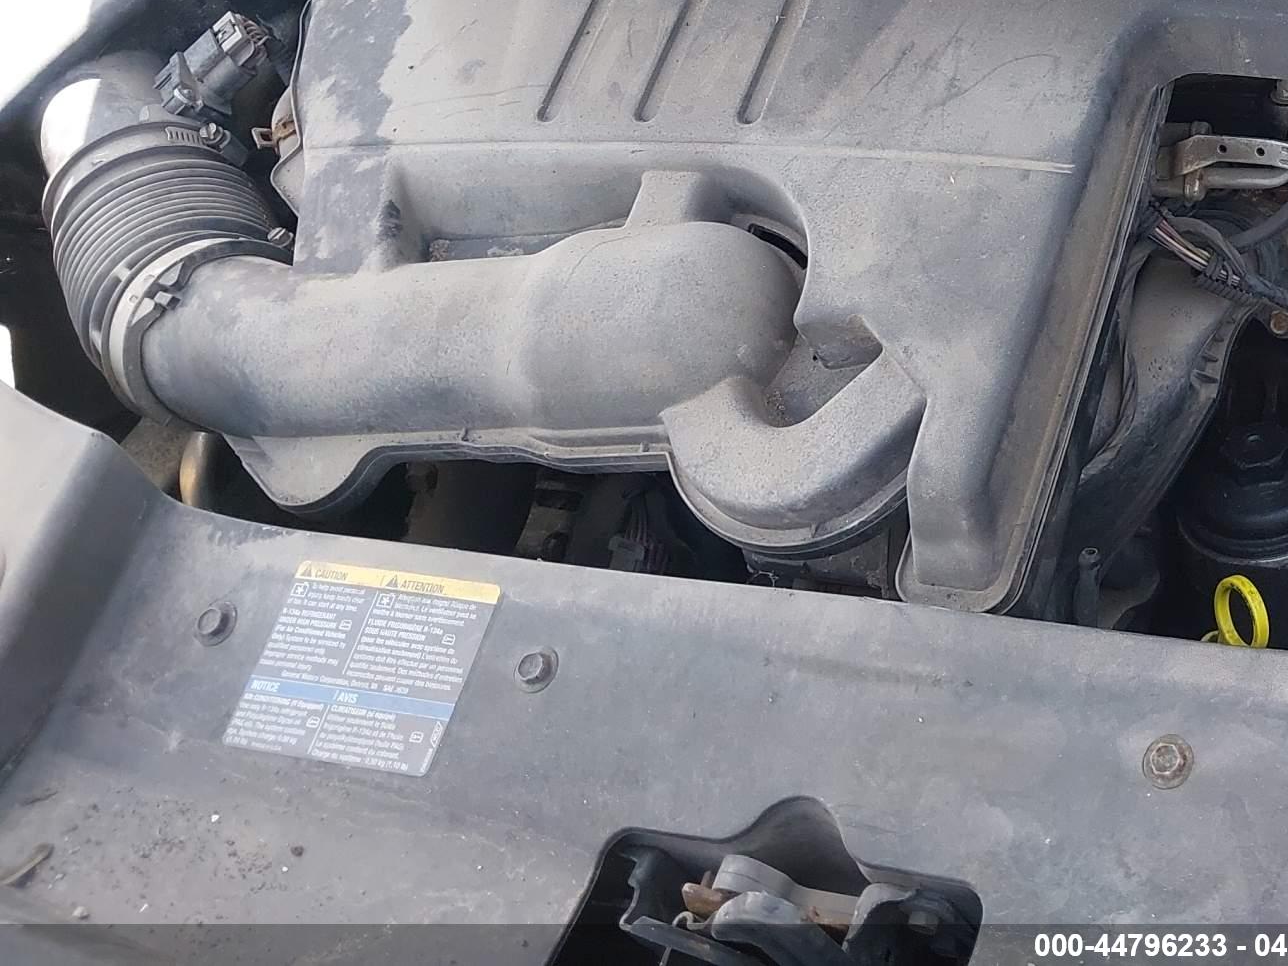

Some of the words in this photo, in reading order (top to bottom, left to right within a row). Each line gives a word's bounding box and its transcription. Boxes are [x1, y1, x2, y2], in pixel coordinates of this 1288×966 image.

[315, 569, 348, 581] CAUTION
[400, 579, 445, 594] ATTENTION
[250, 679, 281, 693] NOTICE
[336, 692, 360, 704] AVIS
